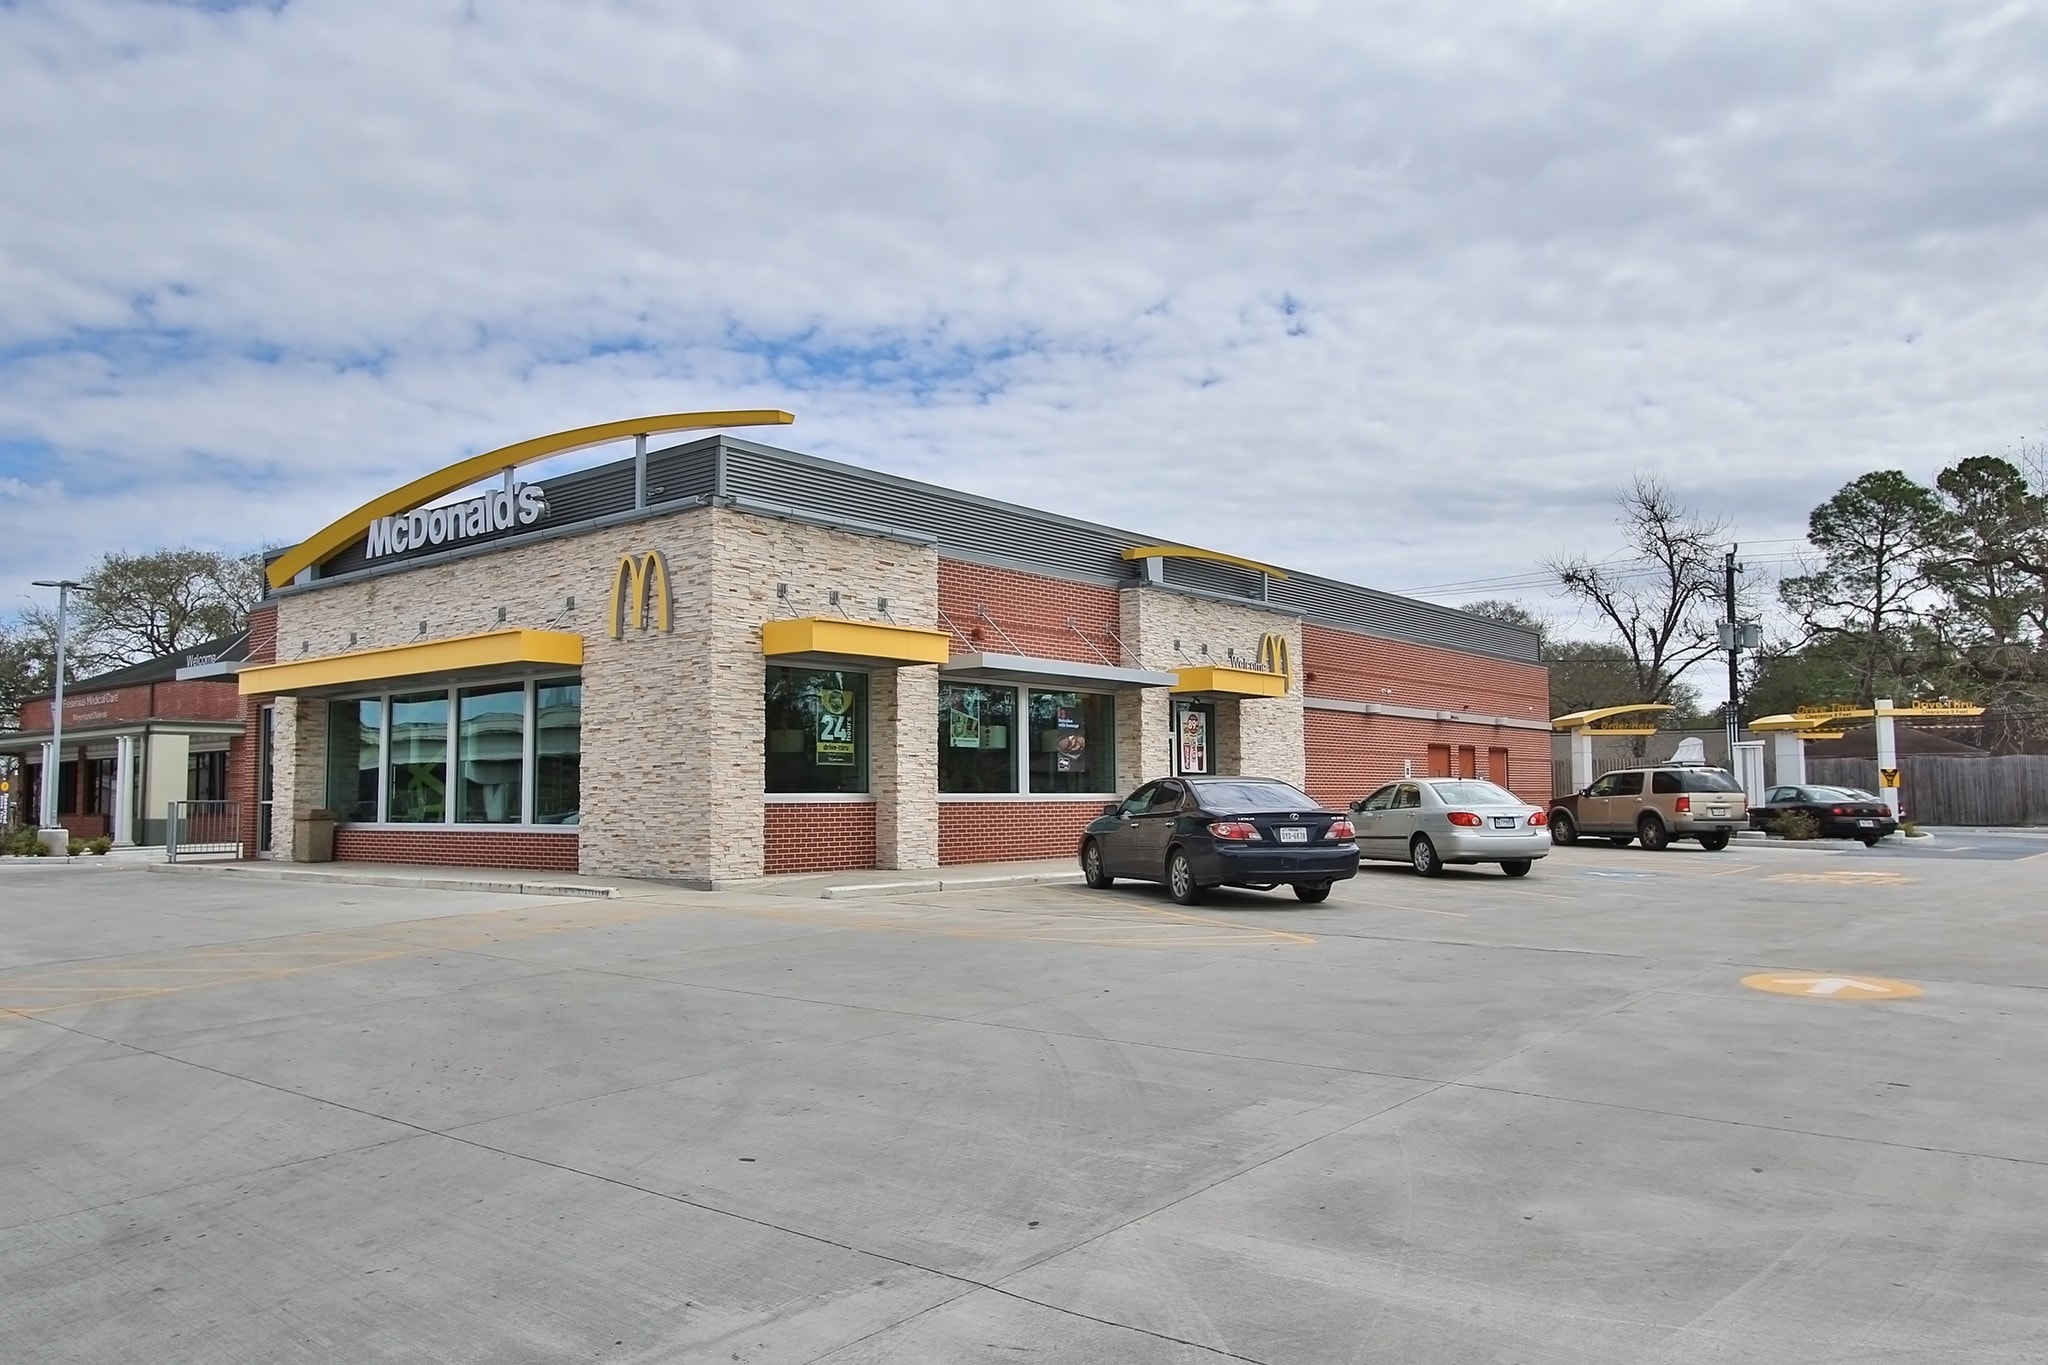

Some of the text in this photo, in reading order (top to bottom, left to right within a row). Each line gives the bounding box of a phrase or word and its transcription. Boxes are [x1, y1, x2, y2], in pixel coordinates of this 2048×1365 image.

[366, 484, 546, 559] McDonald's
[187, 654, 216, 668] Welcome
[821, 715, 847, 741] 24
